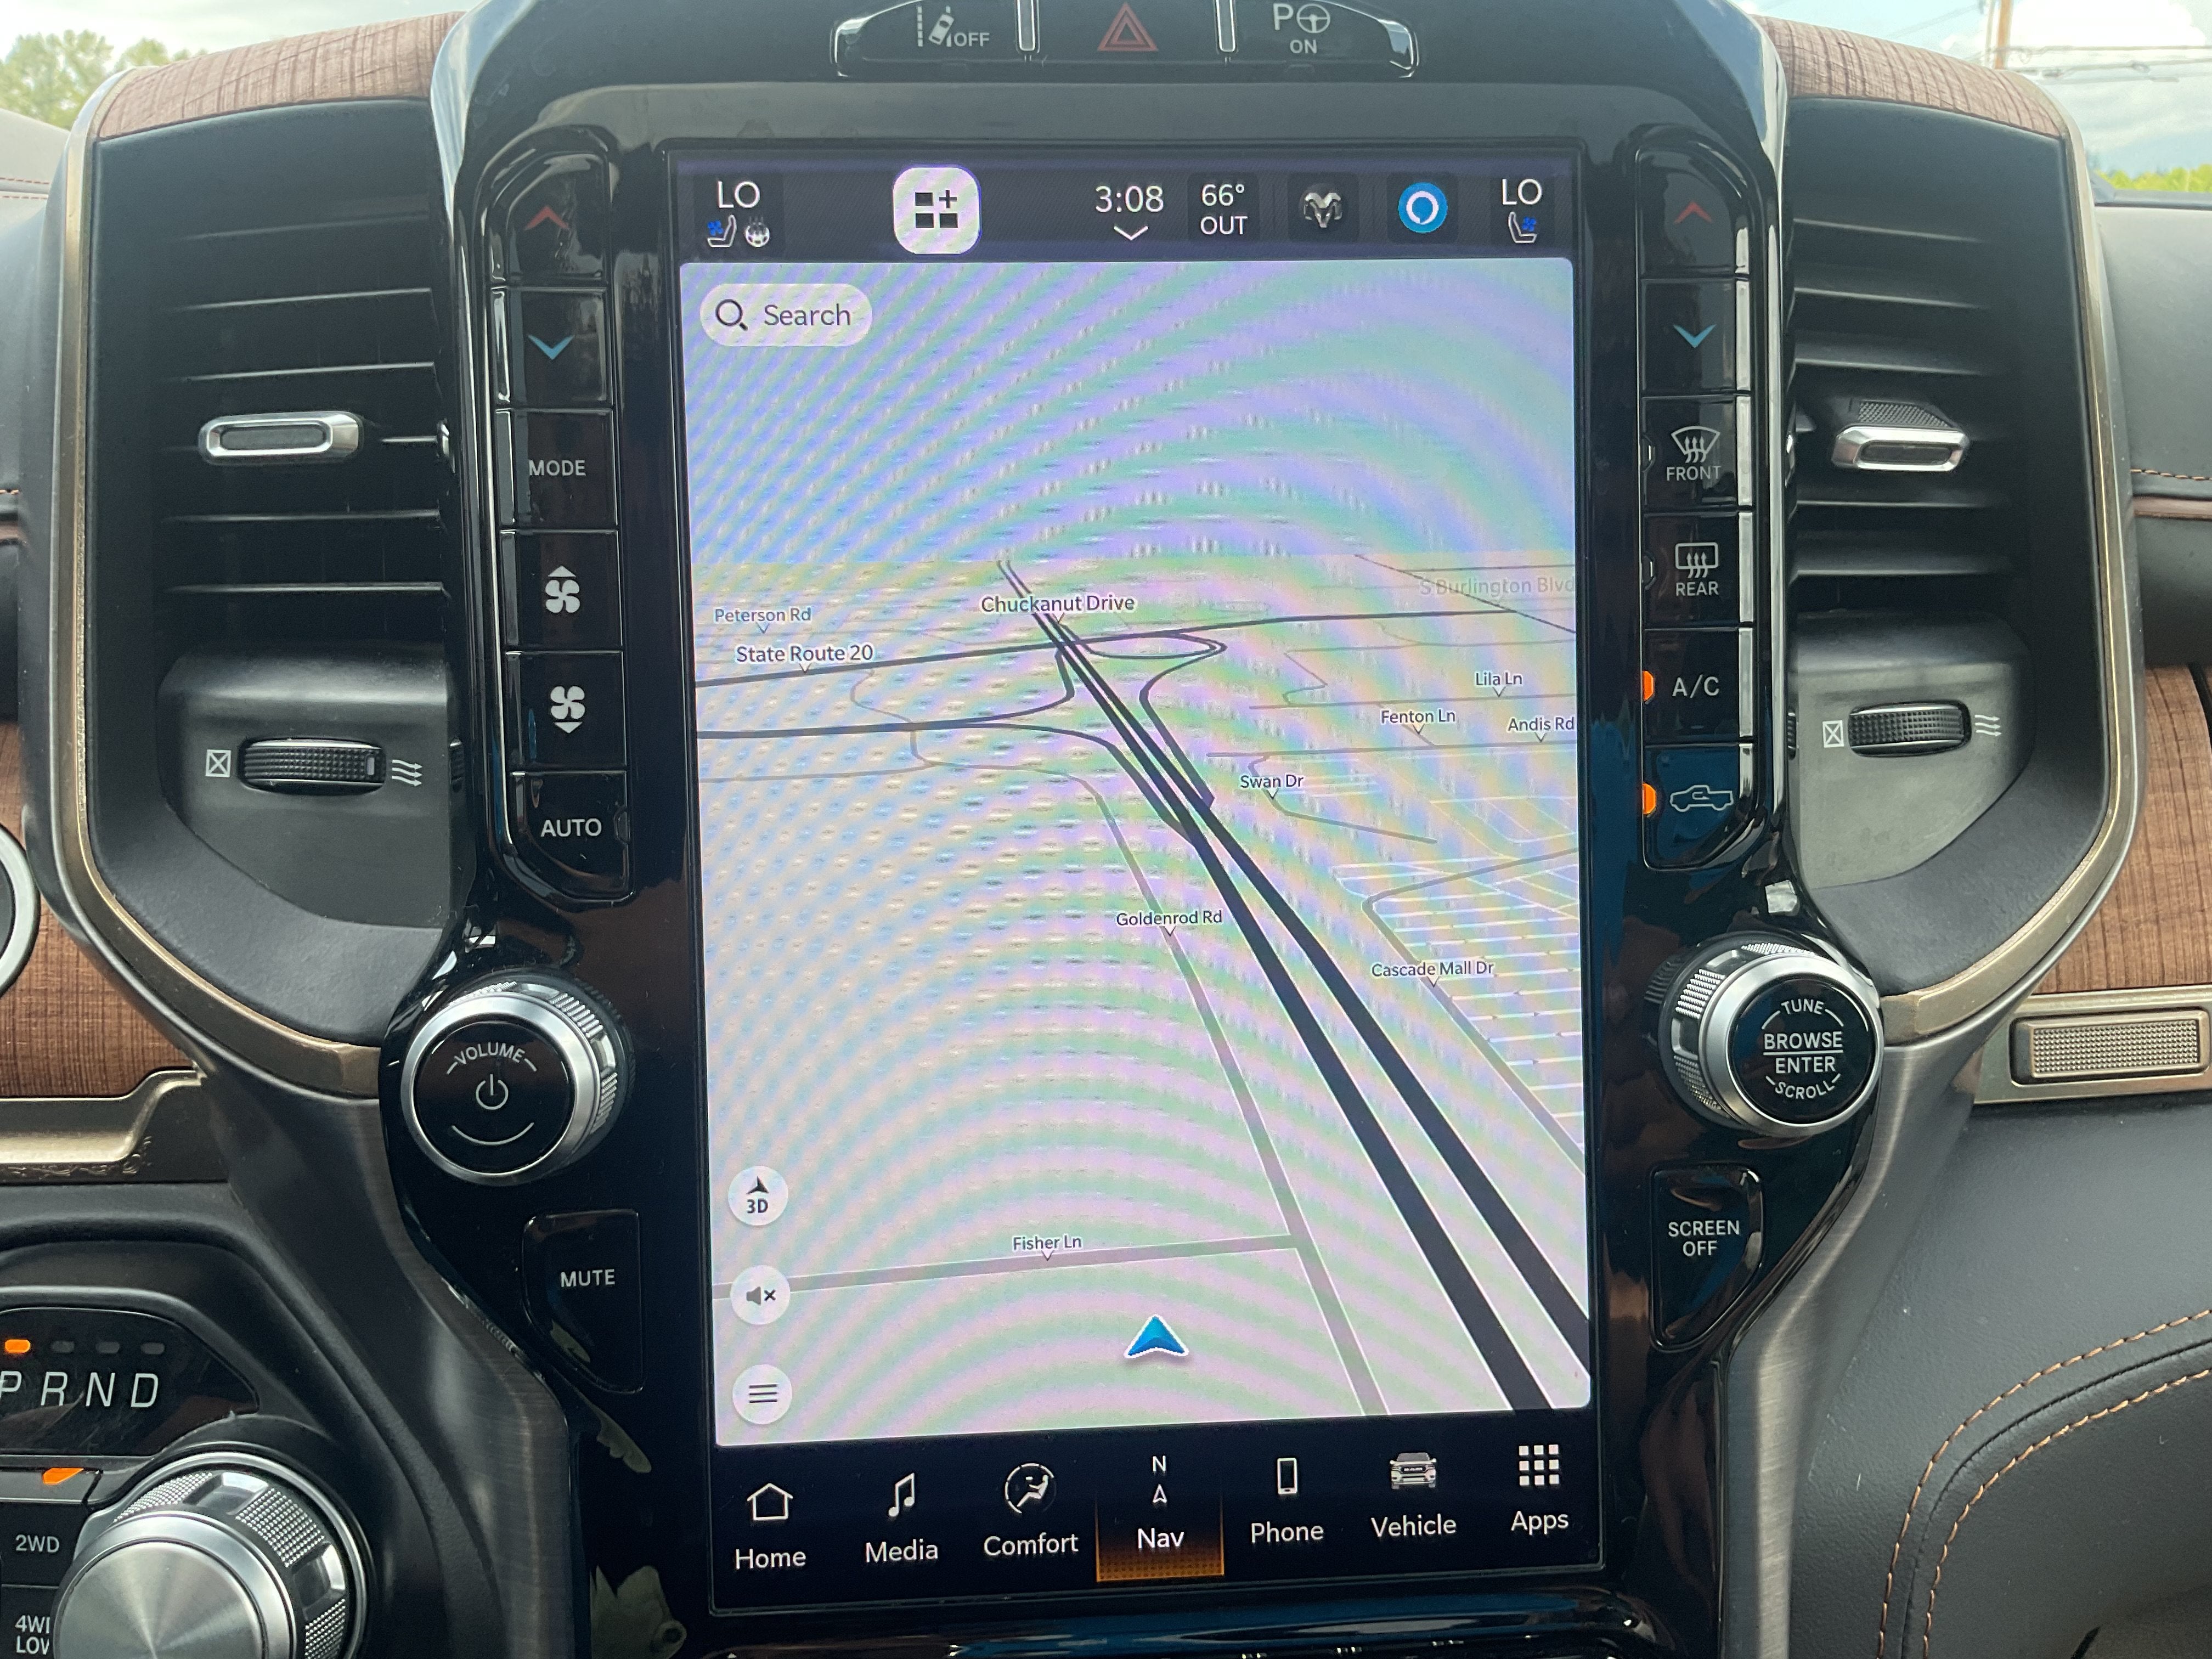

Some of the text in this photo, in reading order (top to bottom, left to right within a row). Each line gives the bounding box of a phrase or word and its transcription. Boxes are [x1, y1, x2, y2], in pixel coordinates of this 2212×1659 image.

[1274, 3, 1295, 31] P
[955, 32, 990, 48] OFF
[1289, 38, 1318, 54] ON
[717, 180, 761, 208] LO
[1095, 185, 1164, 213] 3:08
[1201, 183, 1245, 206] 66°
[1502, 178, 1543, 205] LO
[1200, 216, 1248, 235] OUT
[763, 303, 851, 327] Search
[528, 459, 586, 477] MODE
[1666, 465, 1722, 481] FRONT
[1420, 578, 1575, 597] S Burlington Blvd
[1675, 582, 1719, 596] REAR
[981, 594, 1135, 613] Chuckanut Drive
[714, 606, 812, 623] Peterson Rd
[736, 644, 873, 662] State Route 20
[1475, 672, 1522, 685] Lila Ln
[1672, 674, 1720, 699] A/C
[1381, 709, 1456, 723] Fenton Ln
[1508, 717, 1575, 731] Andis Rd
[1240, 774, 1304, 788] Swan Dr
[540, 817, 602, 838] AUTO
[1116, 909, 1223, 927] Goldenrod Rd
[1371, 961, 1494, 978] Cascade Mall Dr
[1781, 998, 1826, 1015] TUNE
[1763, 1031, 1843, 1050] BROWSE
[455, 1041, 526, 1066] VOLUME
[1775, 1056, 1836, 1074] ENTER
[1774, 1080, 1835, 1100] SCROLL
[746, 1198, 769, 1214] 3D
[1667, 1220, 1741, 1238] SCREEN
[1013, 1235, 1082, 1250] Fisher Ln
[1682, 1240, 1718, 1257] OFF
[560, 1268, 616, 1288] MUTE
[0, 1370, 160, 1408] P R N D
[1152, 1455, 1167, 1473] N
[1370, 1514, 1457, 1538] Vehicle
[1510, 1510, 1570, 1535] Apps
[1137, 1527, 1185, 1549] Nav
[1251, 1521, 1325, 1544] Phone
[15, 1534, 60, 1553] 2WD
[865, 1538, 939, 1563] Media
[983, 1531, 1079, 1557] Comfort
[734, 1549, 807, 1570] Home
